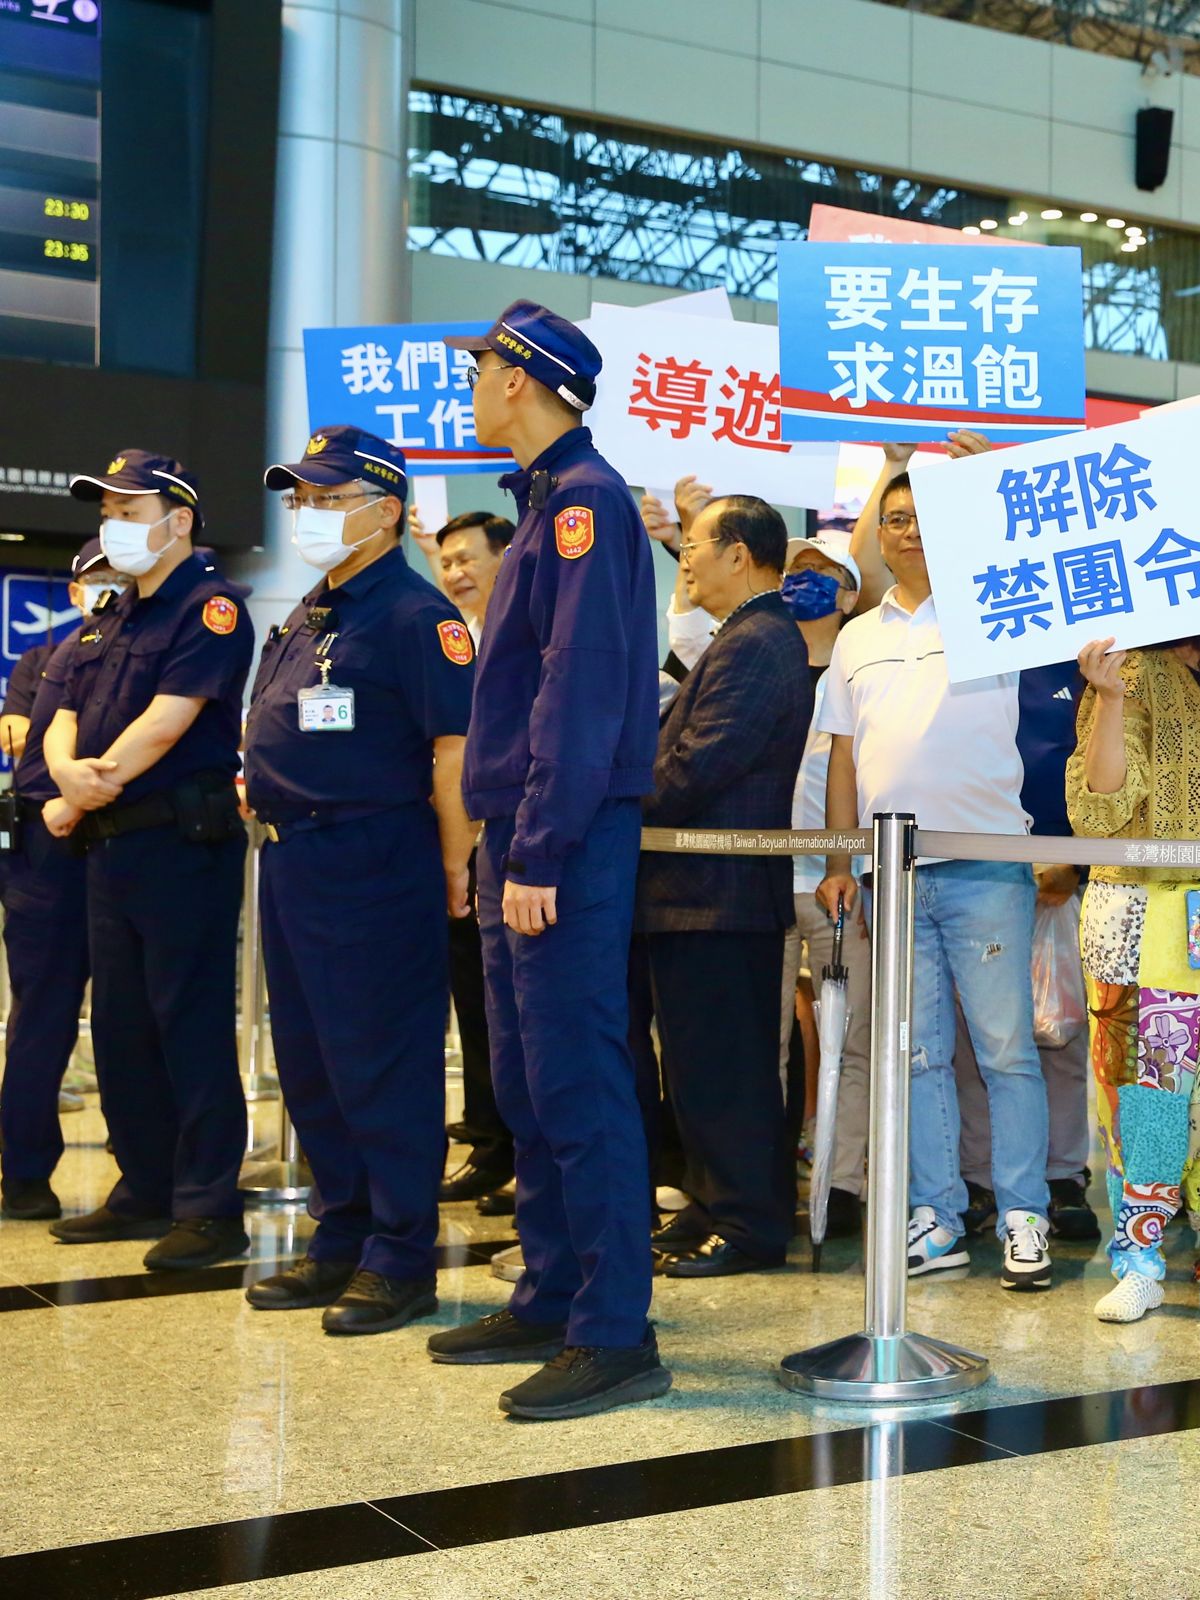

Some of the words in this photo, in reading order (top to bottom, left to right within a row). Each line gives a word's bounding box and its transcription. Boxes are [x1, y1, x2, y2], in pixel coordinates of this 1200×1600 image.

[45, 198, 89, 220] 23:30
[824, 266, 1039, 333] 要生存
[628, 353, 792, 453] 導遊
[828, 341, 1042, 409] 求溫飽
[375, 398, 477, 448] 工作
[997, 444, 1157, 540] 解除
[338, 704, 348, 720] 6
[732, 834, 757, 849] Taiwan
[757, 834, 788, 853] Taoyuan
[788, 835, 836, 850] International
[836, 835, 866, 852] Airport
